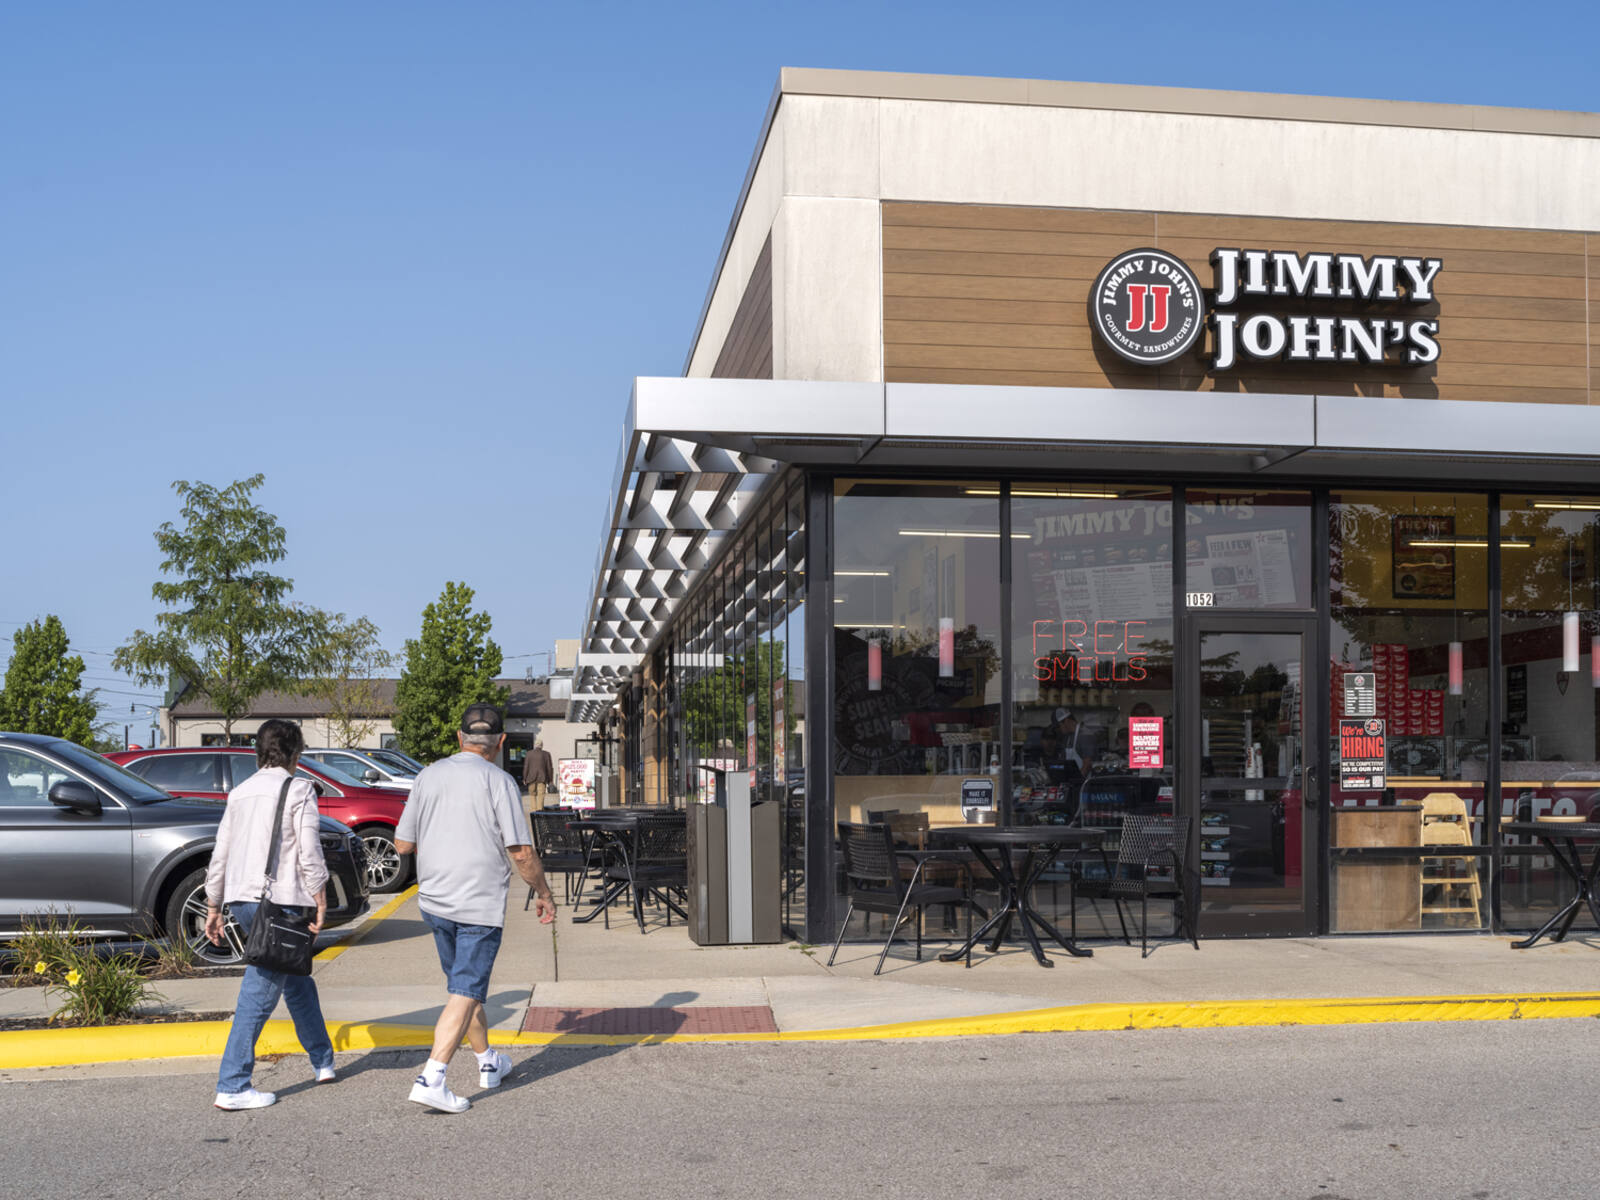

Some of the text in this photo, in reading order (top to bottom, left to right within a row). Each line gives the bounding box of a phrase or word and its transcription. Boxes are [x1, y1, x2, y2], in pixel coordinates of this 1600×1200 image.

[1103, 260, 1194, 307] JIMMY JOHN'S
[1216, 250, 1442, 304] JIMMY
[1126, 283, 1171, 333] JJ
[1105, 314, 1192, 353] GOURMET SANDWICHES
[1215, 314, 1439, 368] JOHN'S
[1034, 507, 1137, 546] JIMMY
[1033, 620, 1148, 655] FREE
[1033, 657, 1148, 681] SMELLS
[1342, 737, 1384, 758] HIRING
